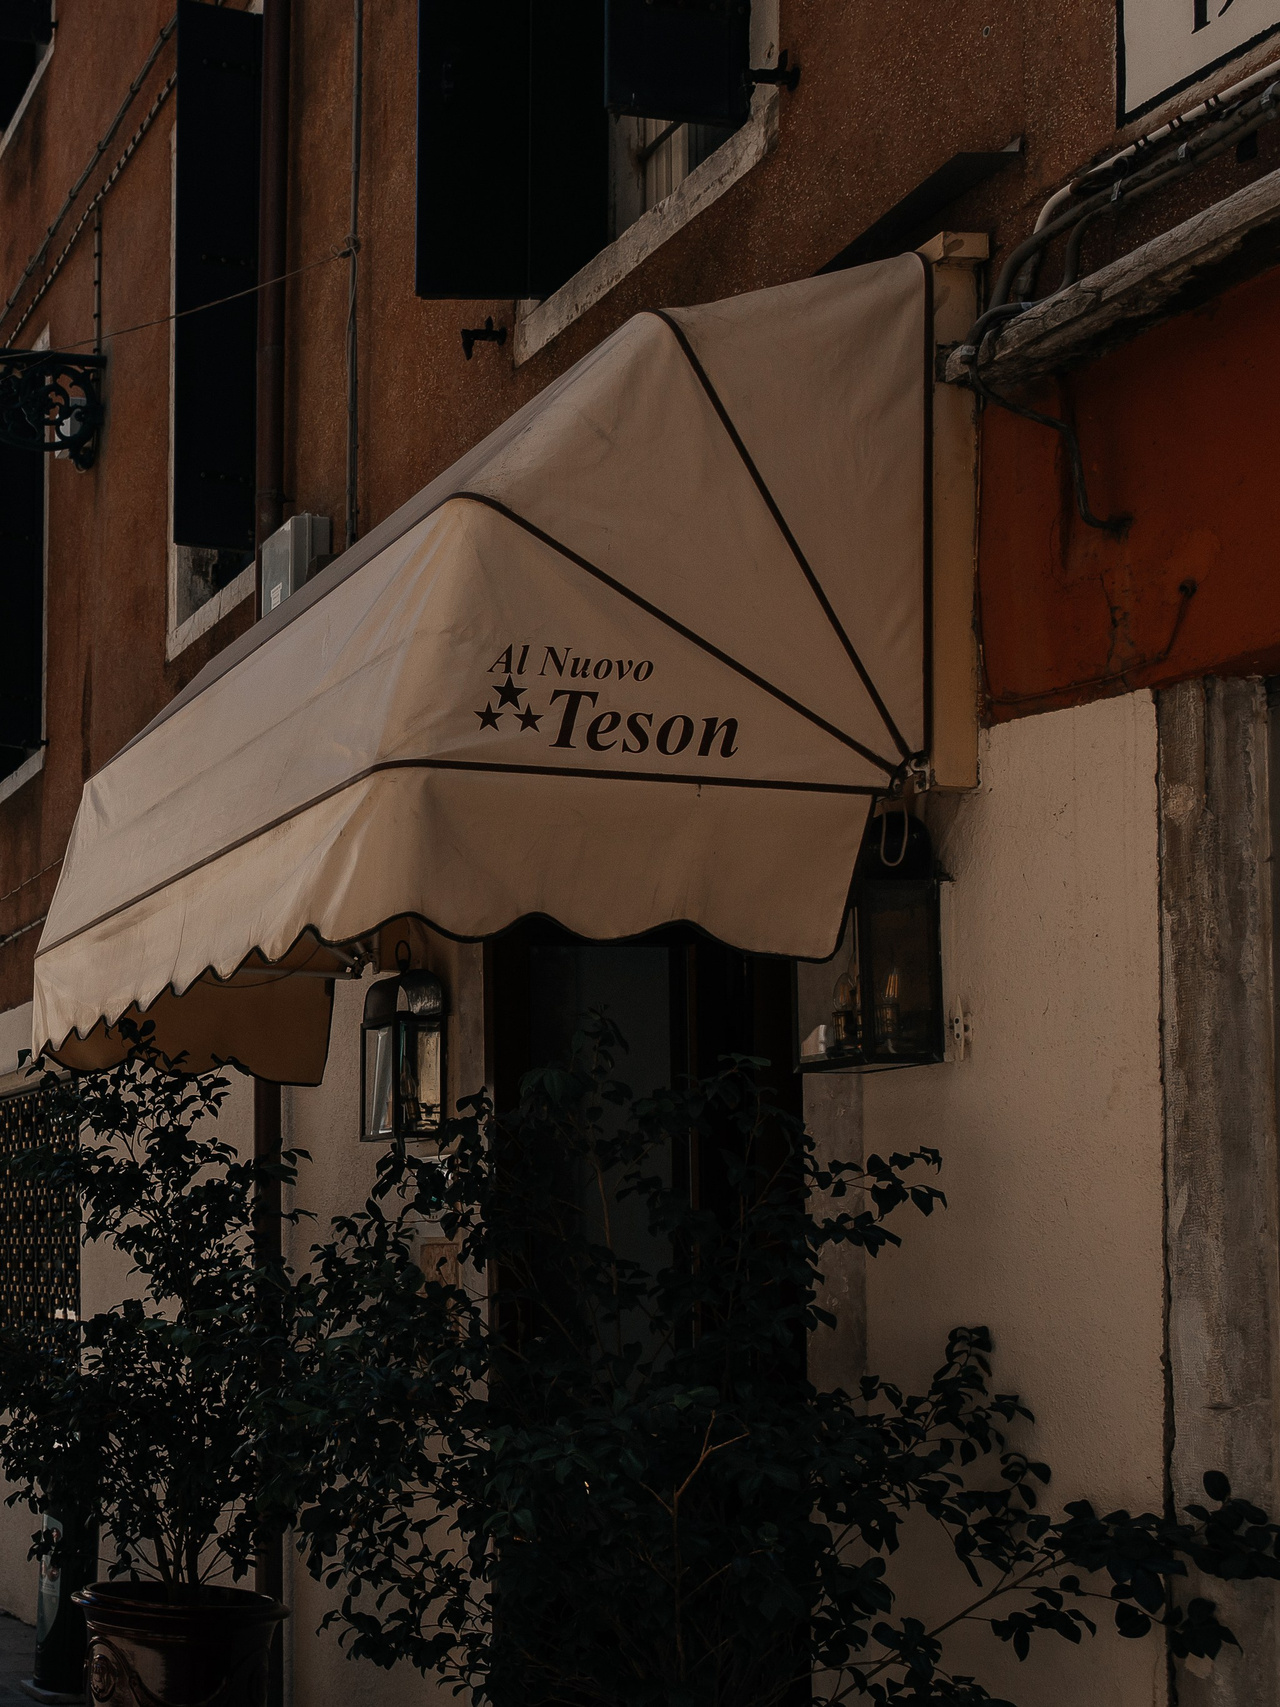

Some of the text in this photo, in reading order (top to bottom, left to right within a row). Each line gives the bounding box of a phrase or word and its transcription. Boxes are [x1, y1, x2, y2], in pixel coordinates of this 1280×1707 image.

[486, 643, 654, 682] Al Nuovo
[548, 689, 739, 758] Teson
